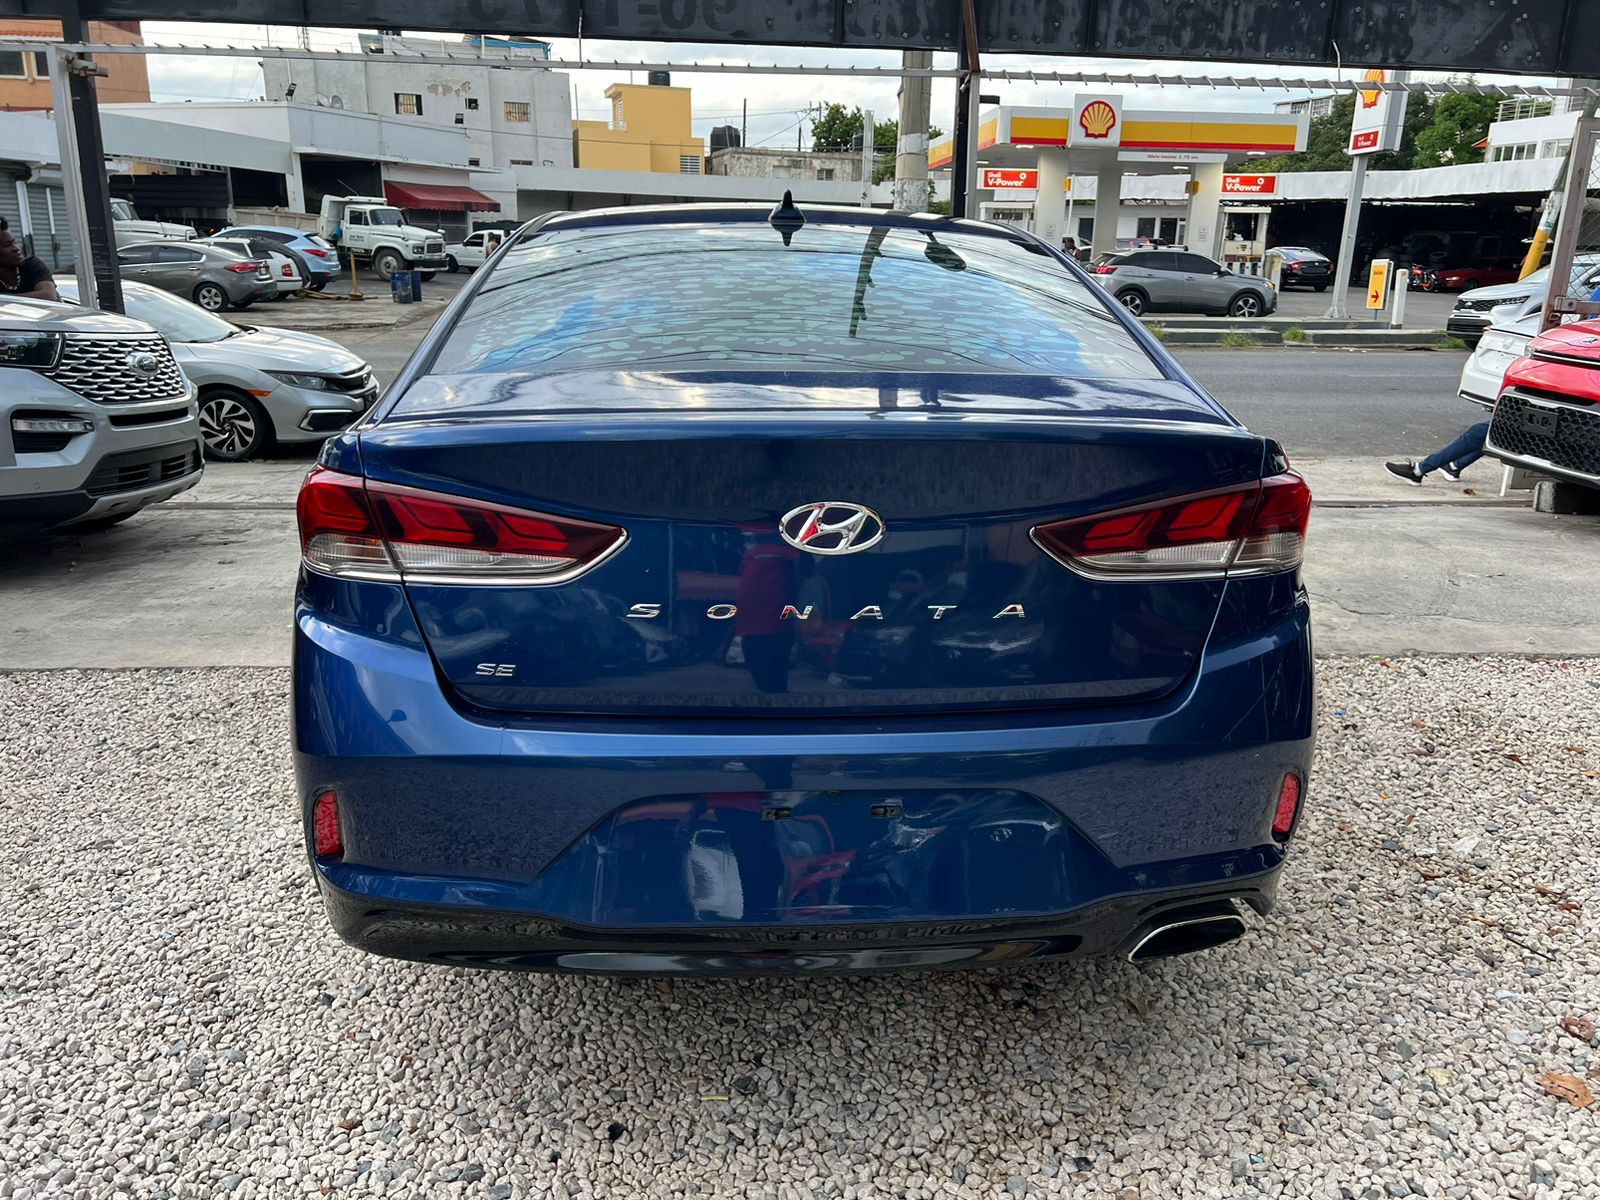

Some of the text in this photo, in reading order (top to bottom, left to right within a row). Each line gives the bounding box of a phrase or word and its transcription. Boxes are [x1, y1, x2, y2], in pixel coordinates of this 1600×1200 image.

[987, 178, 1024, 186] V-Power
[1225, 183, 1262, 191] V-Power
[625, 603, 1027, 620] SONATA
[475, 663, 516, 677] SE
